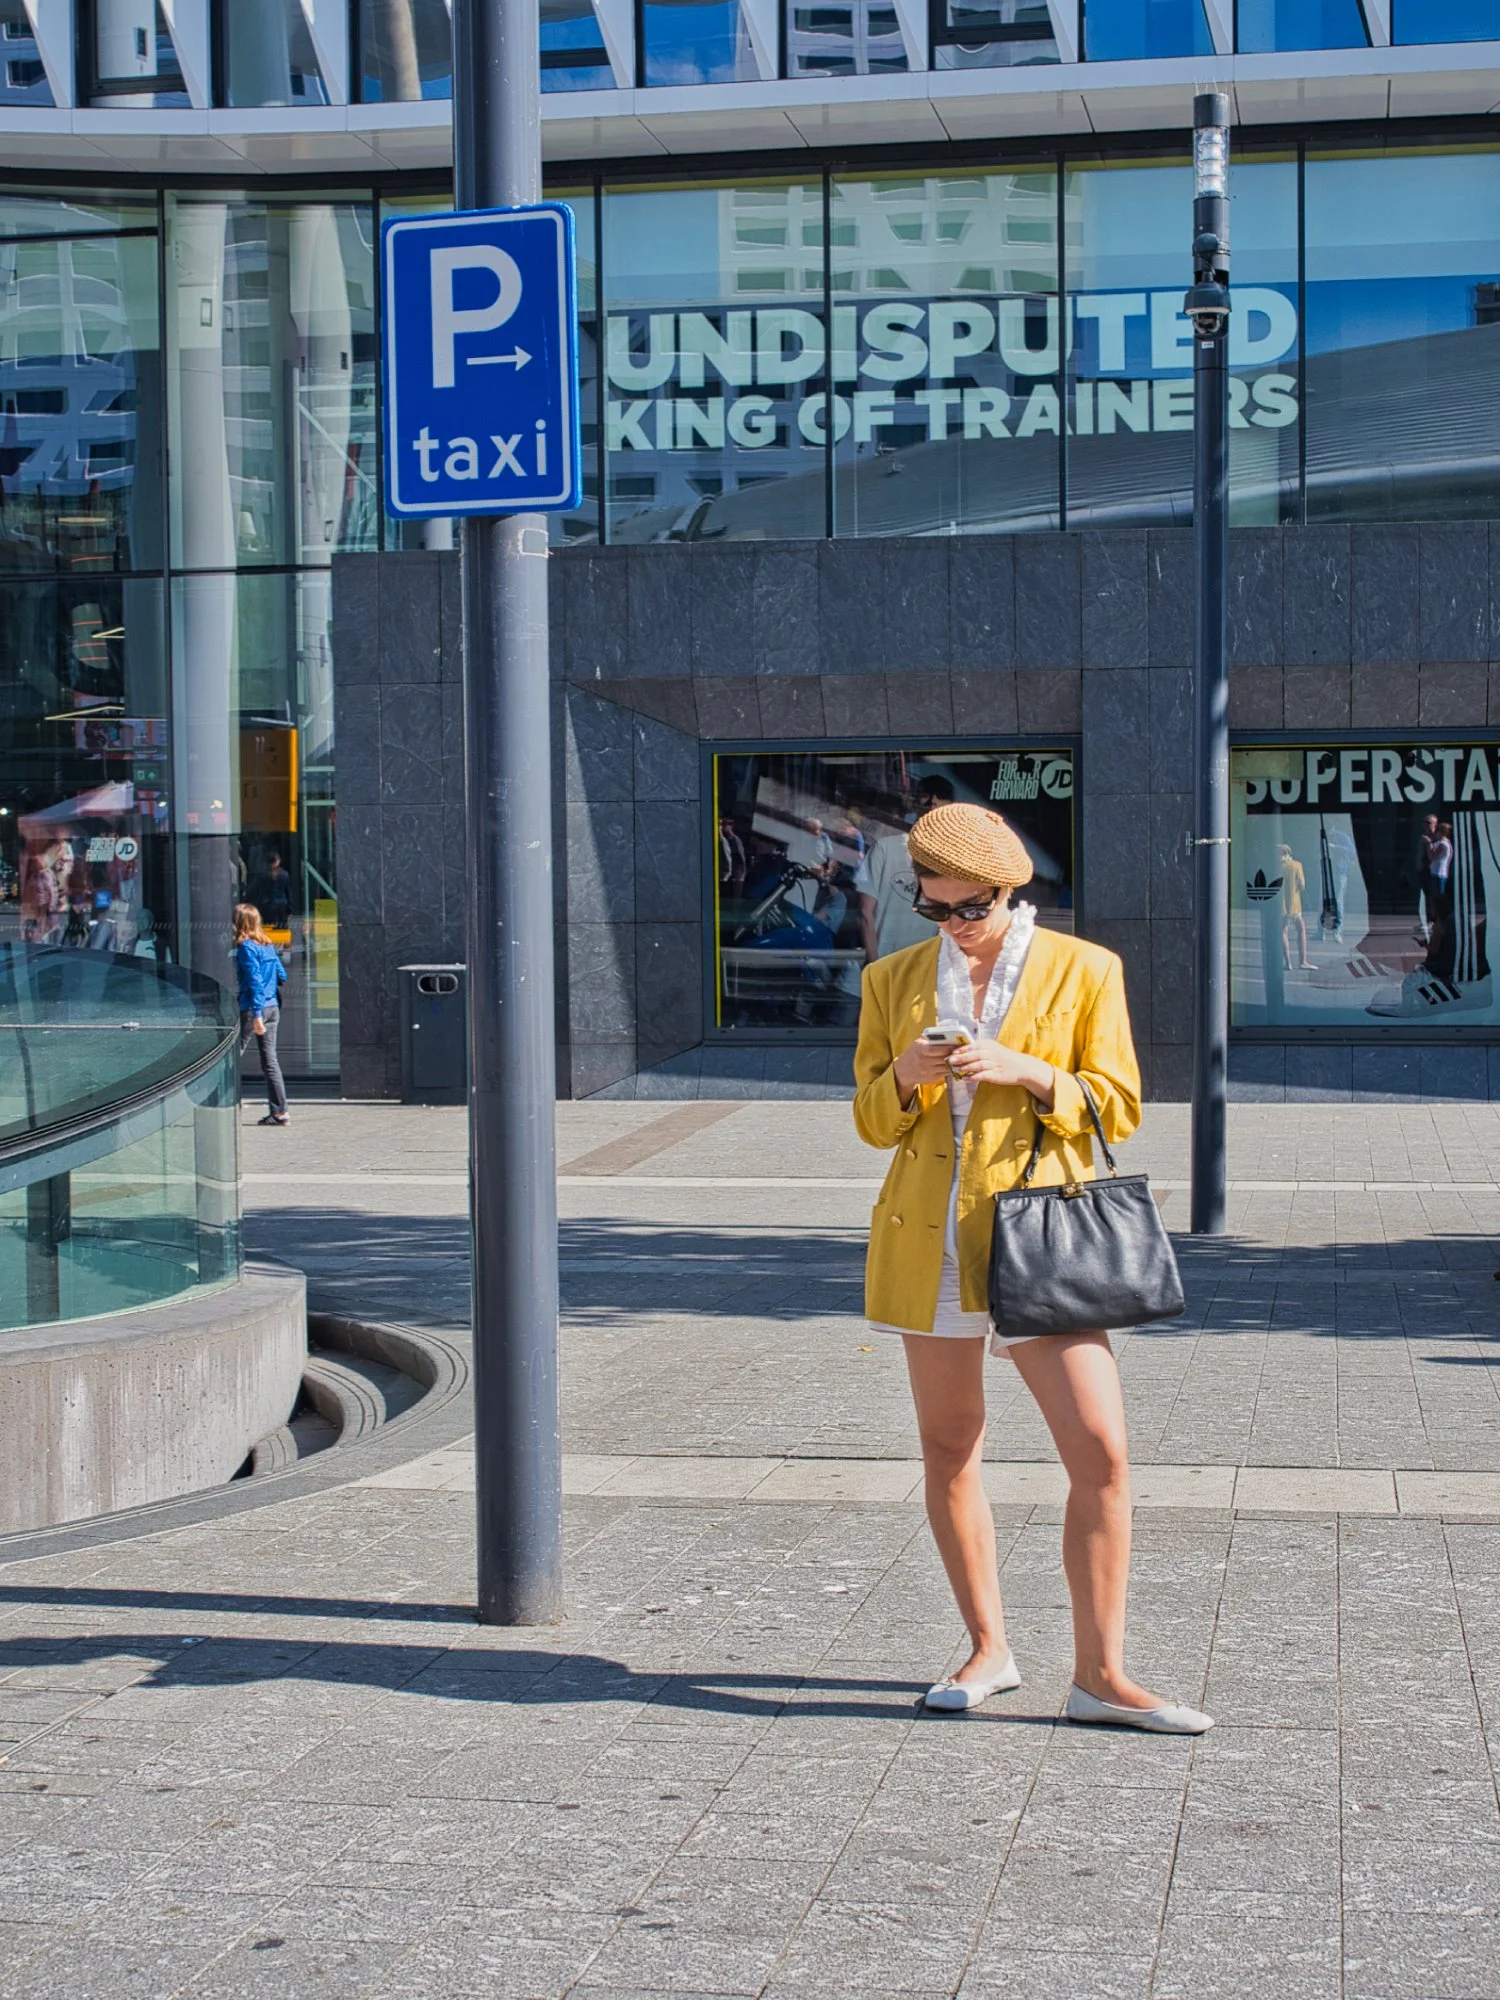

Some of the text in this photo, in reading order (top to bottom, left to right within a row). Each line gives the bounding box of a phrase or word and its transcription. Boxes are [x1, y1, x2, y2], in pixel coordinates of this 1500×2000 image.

[430, 245, 522, 388] P
[607, 288, 1298, 391] UNDISPUTED
[608, 395, 776, 451] KING
[798, 391, 895, 446] OF
[413, 419, 547, 482] taxi
[990, 780, 1039, 800] FORWARD
[1047, 769, 1072, 789] JD
[1246, 748, 1500, 804] UPERSTA
[119, 843, 135, 855] JD
